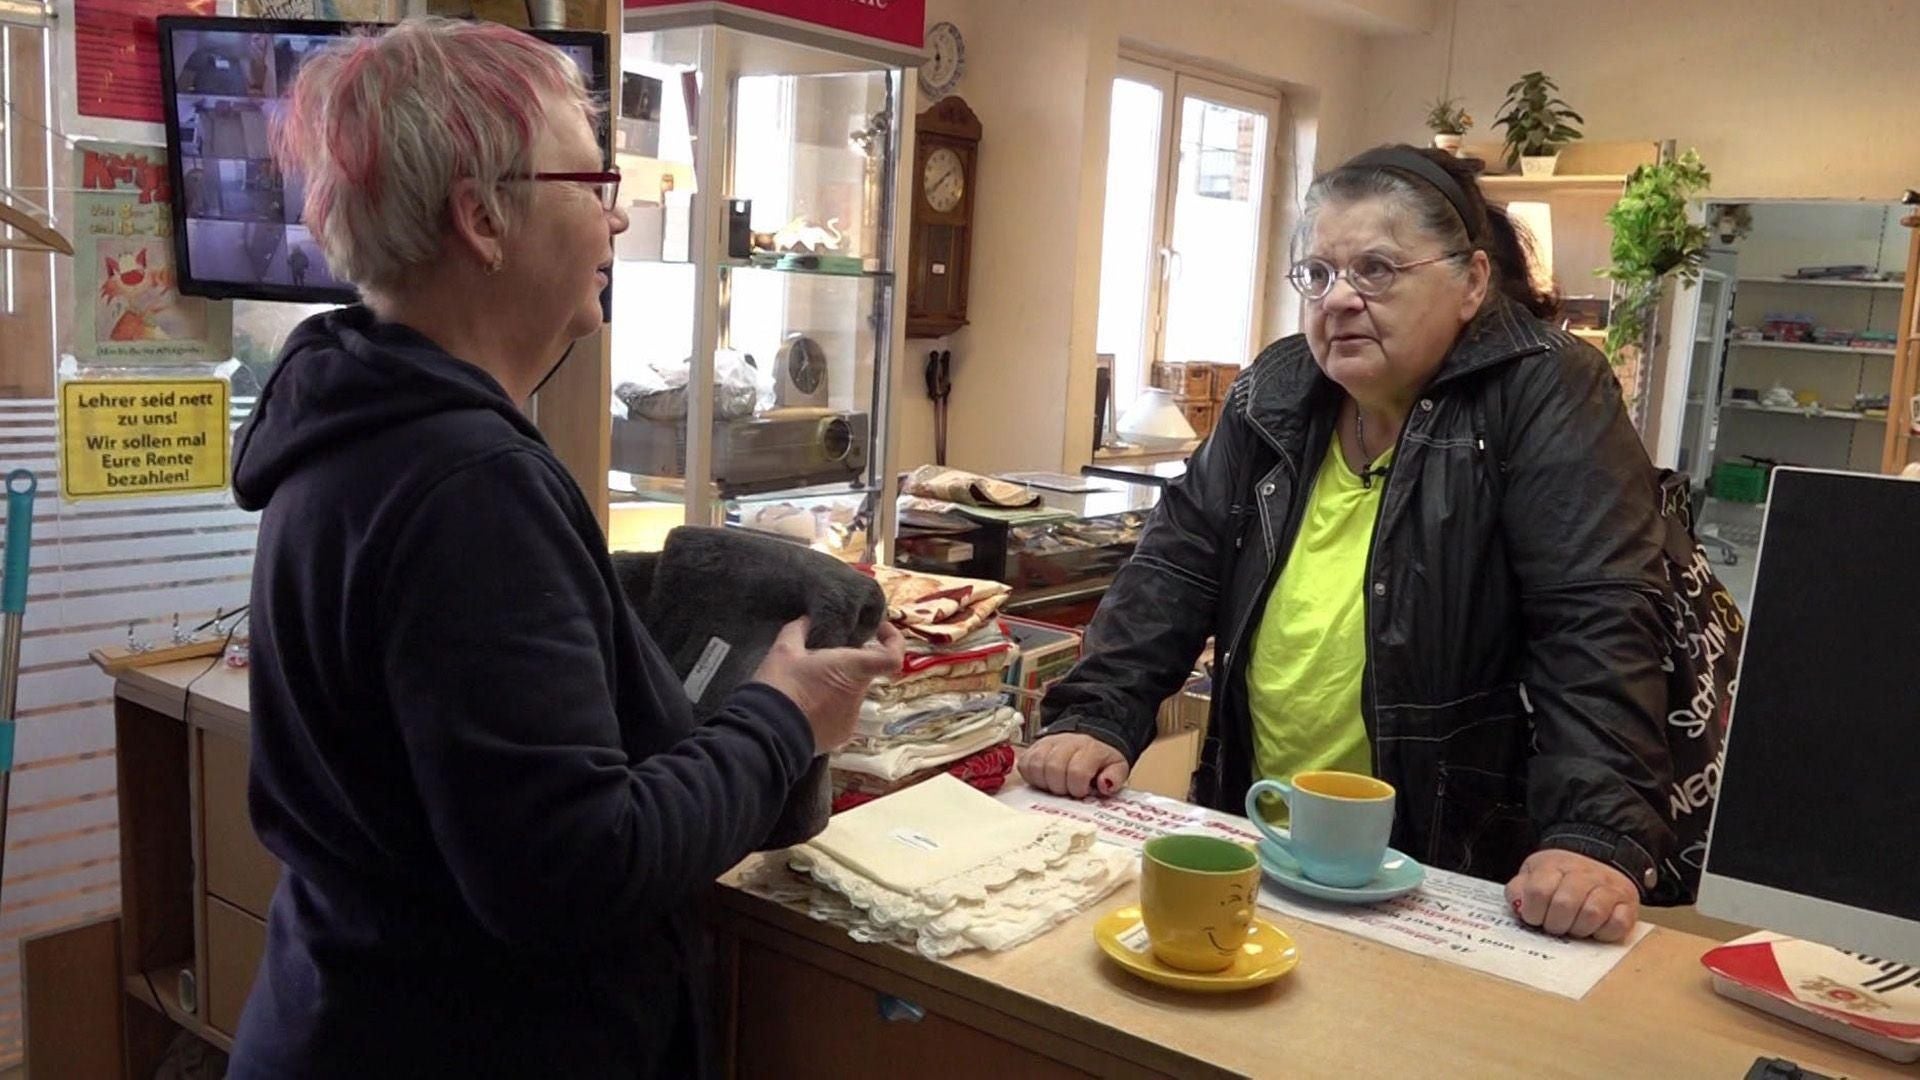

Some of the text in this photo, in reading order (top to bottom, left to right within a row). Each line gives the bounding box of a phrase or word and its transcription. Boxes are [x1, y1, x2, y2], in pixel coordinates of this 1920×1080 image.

[78, 391, 213, 408] Lehrer seid nett
[117, 411, 178, 426] zu uns!
[86, 432, 206, 450] Wir sollen mal
[102, 452, 194, 468] Eure Rente
[107, 469, 189, 487] bezahlen!
